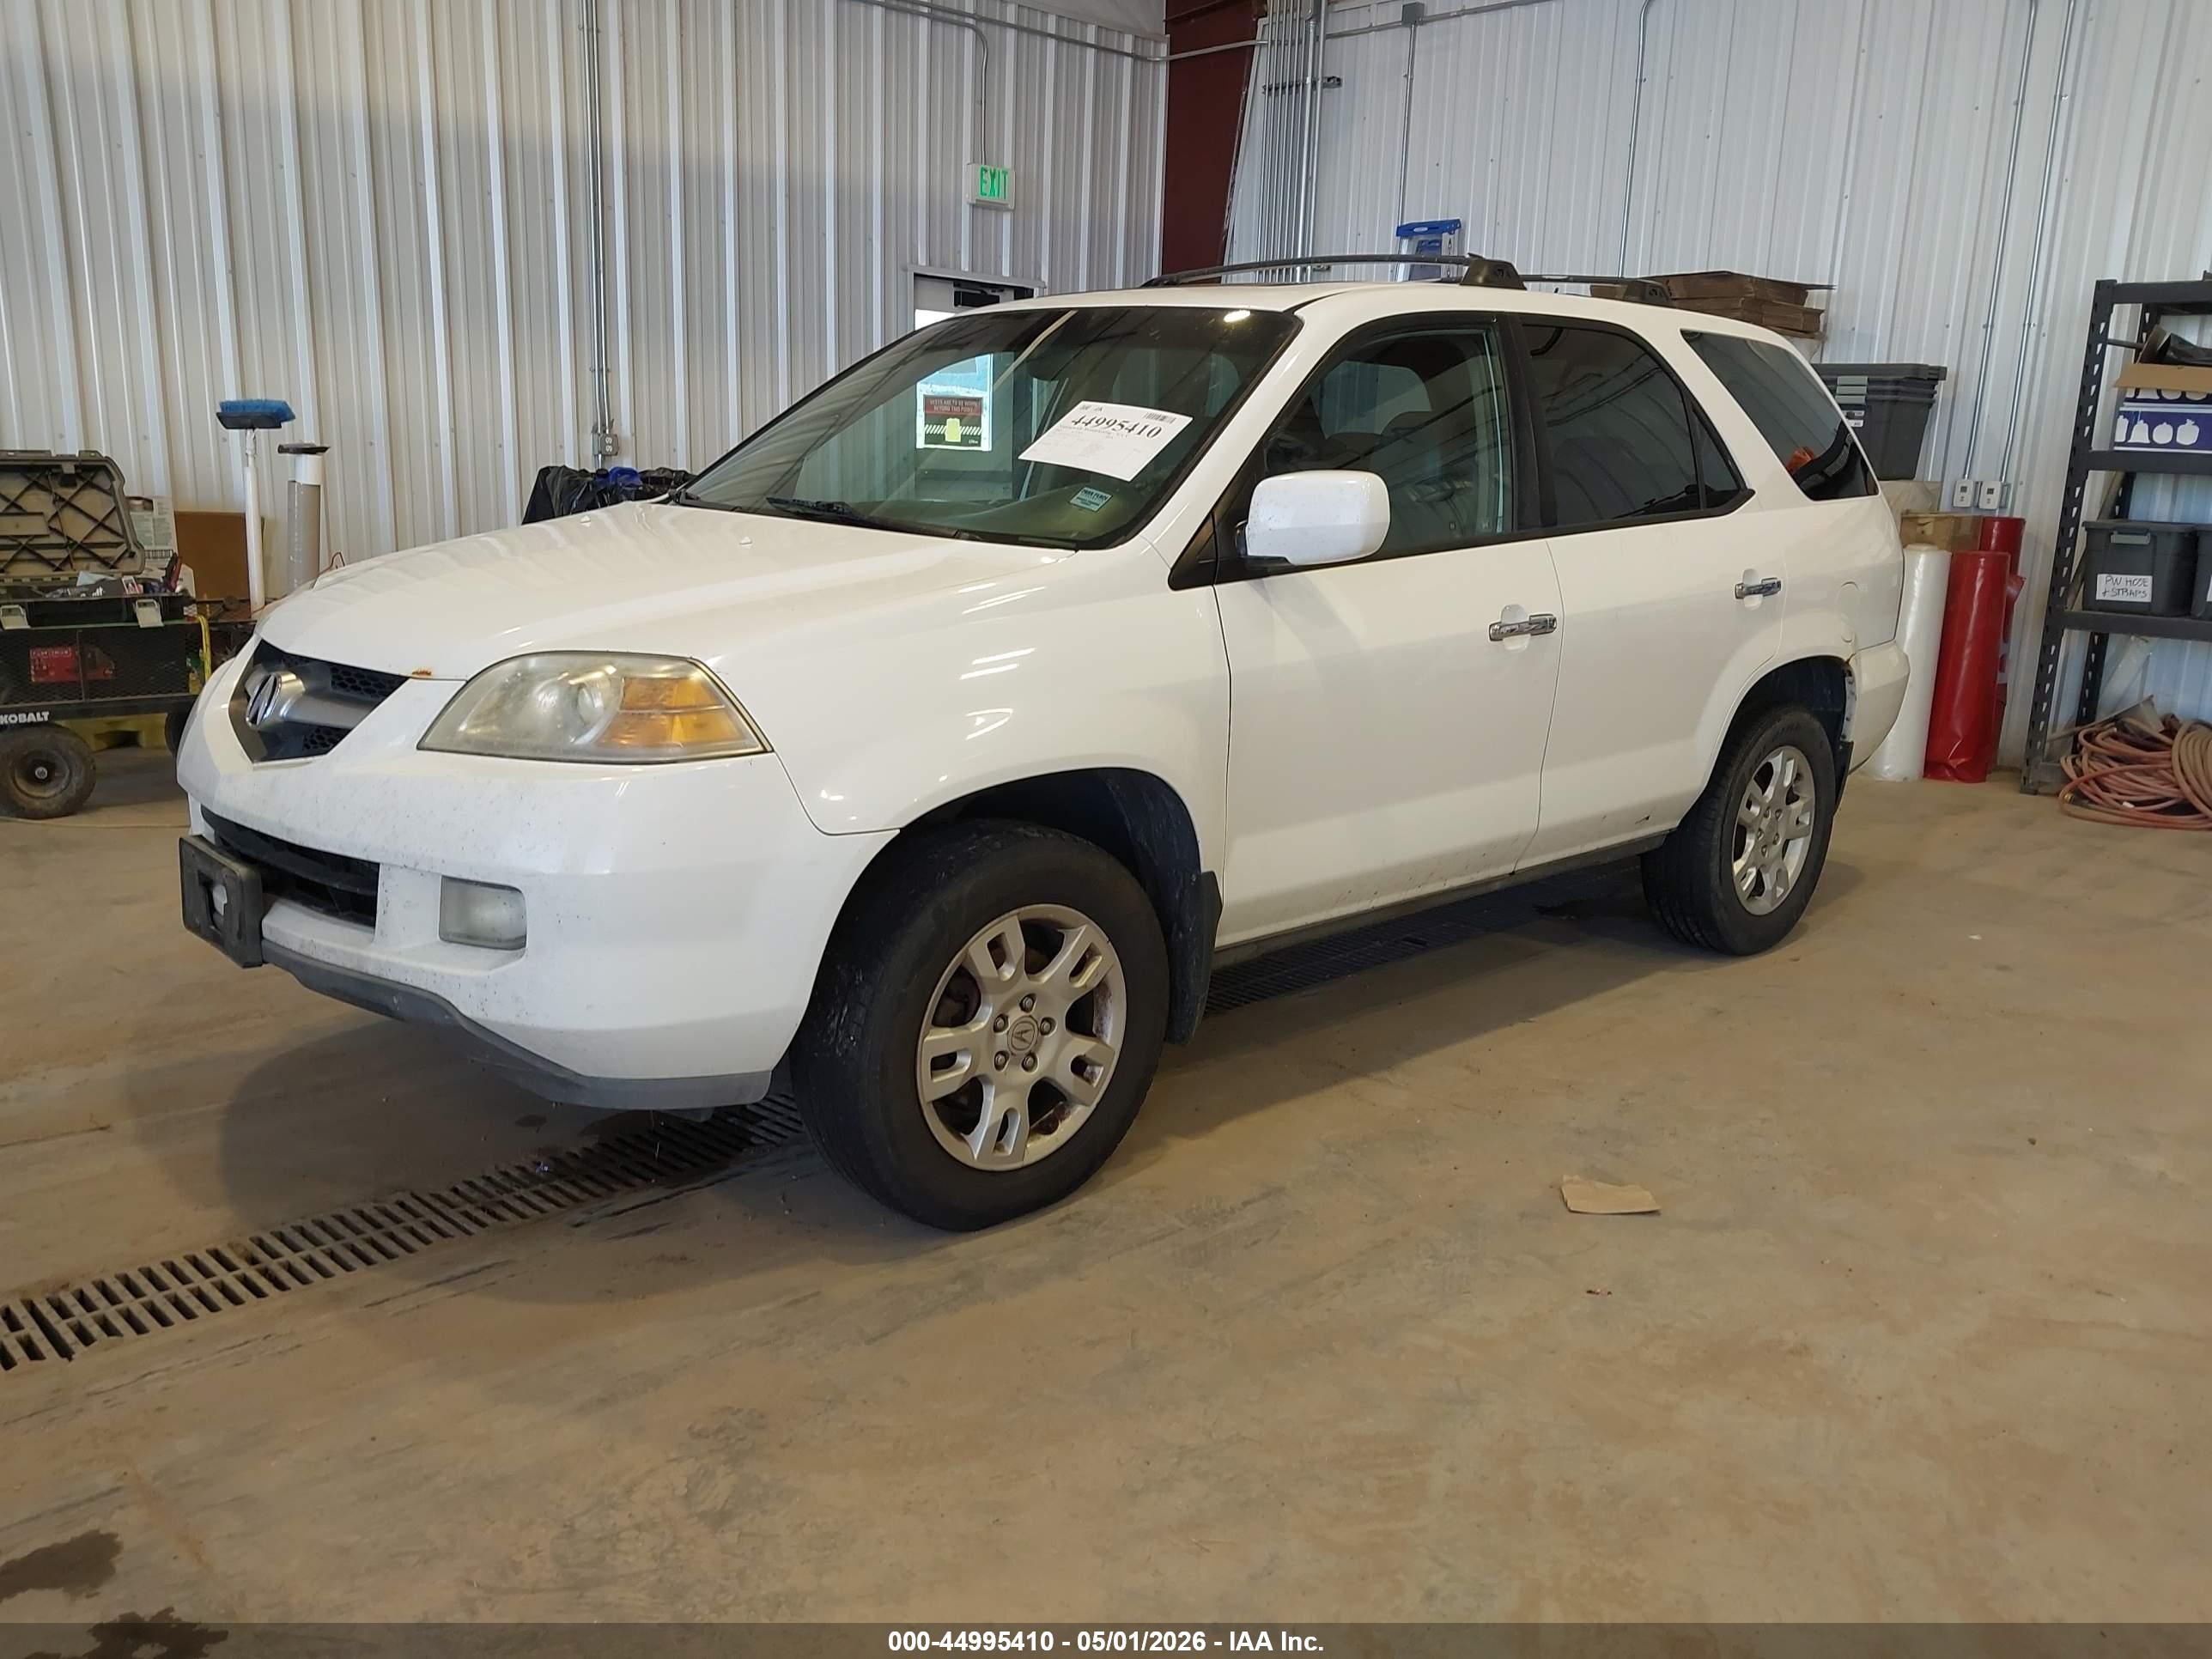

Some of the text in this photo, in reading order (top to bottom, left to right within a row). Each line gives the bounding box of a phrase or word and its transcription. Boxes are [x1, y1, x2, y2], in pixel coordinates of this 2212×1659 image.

[980, 166, 1008, 199] EXIT
[1072, 414, 1163, 439] 44995410
[2105, 574, 2148, 587] PW HOSE
